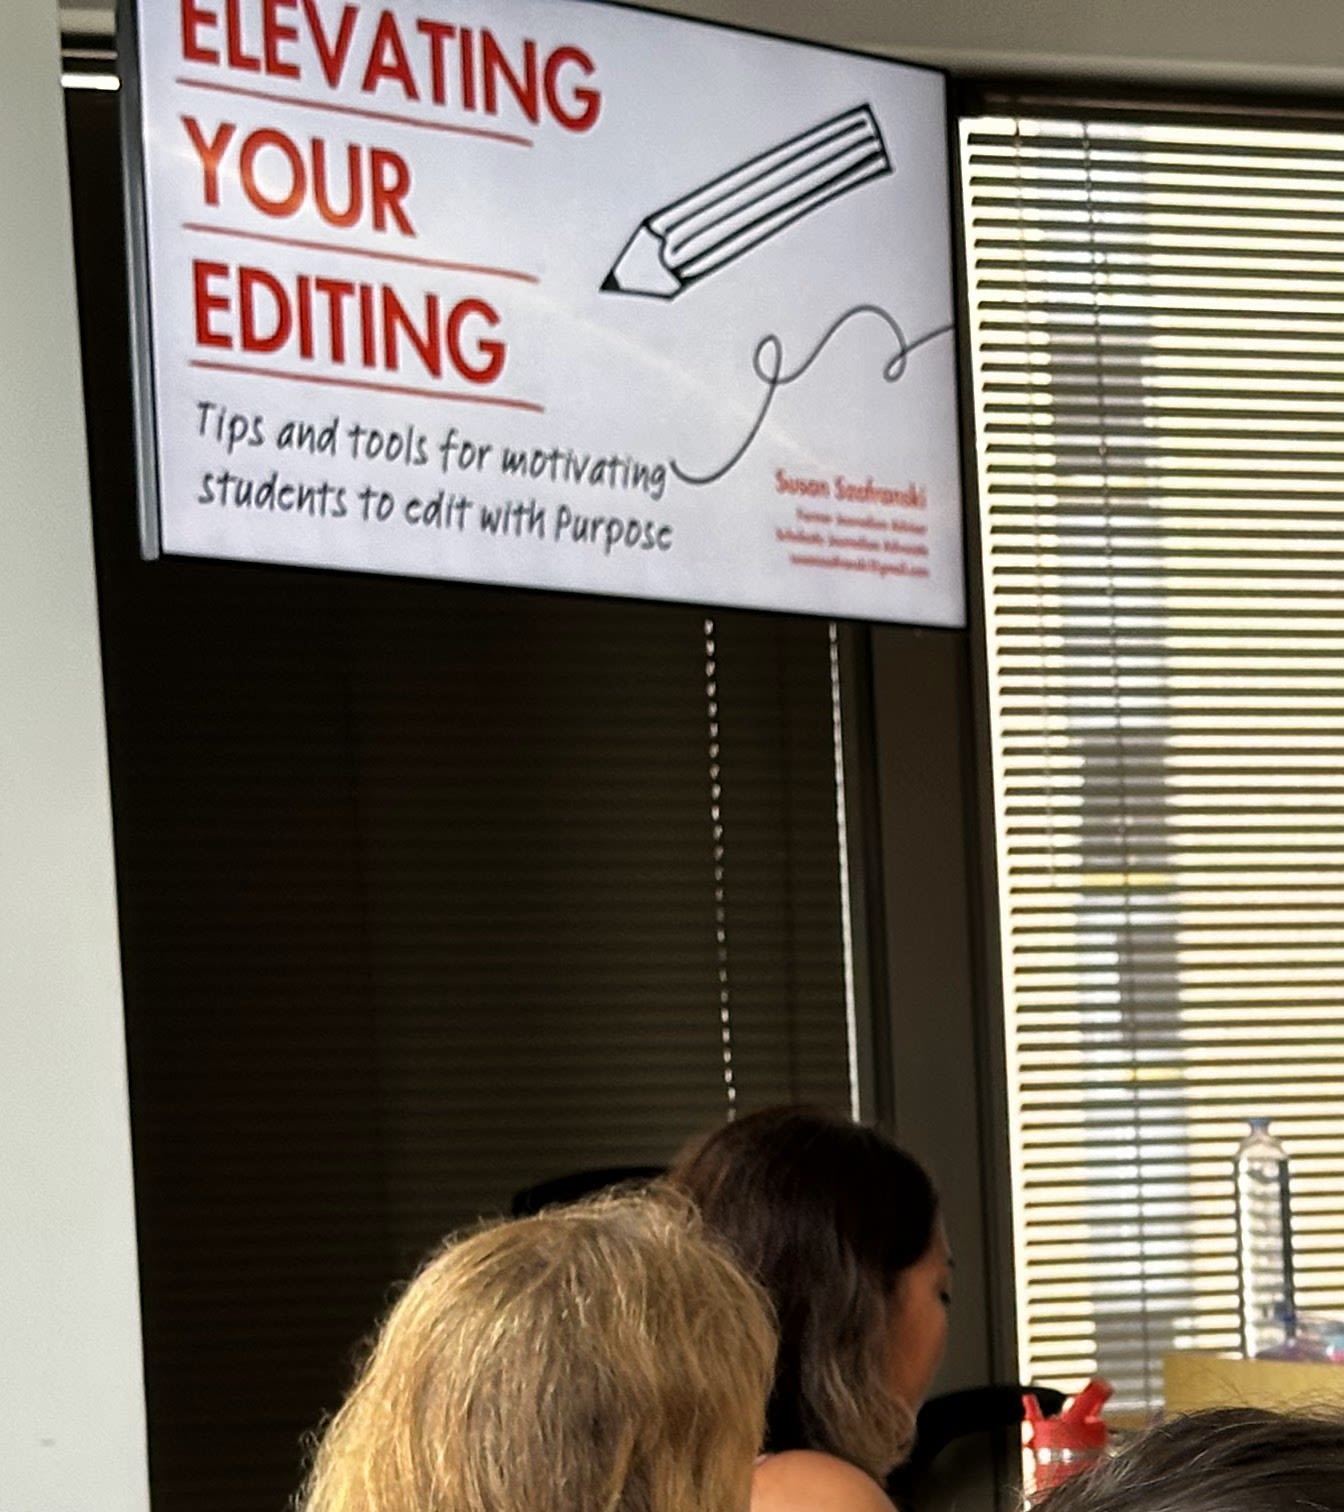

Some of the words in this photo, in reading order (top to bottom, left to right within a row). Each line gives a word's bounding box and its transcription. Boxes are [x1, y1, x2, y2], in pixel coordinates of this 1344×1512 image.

[178, 0, 601, 133] ELEVATING
[178, 113, 416, 239] YOUR
[192, 257, 506, 386] EDITING
[196, 400, 264, 455] Tips
[277, 416, 339, 458] and
[347, 422, 429, 467] tools
[439, 427, 493, 474] for
[501, 446, 667, 501] motivating
[198, 470, 347, 521] students
[359, 483, 395, 522] to
[404, 489, 474, 533] edit
[479, 497, 547, 541] with
[554, 506, 674, 555] Purpose
